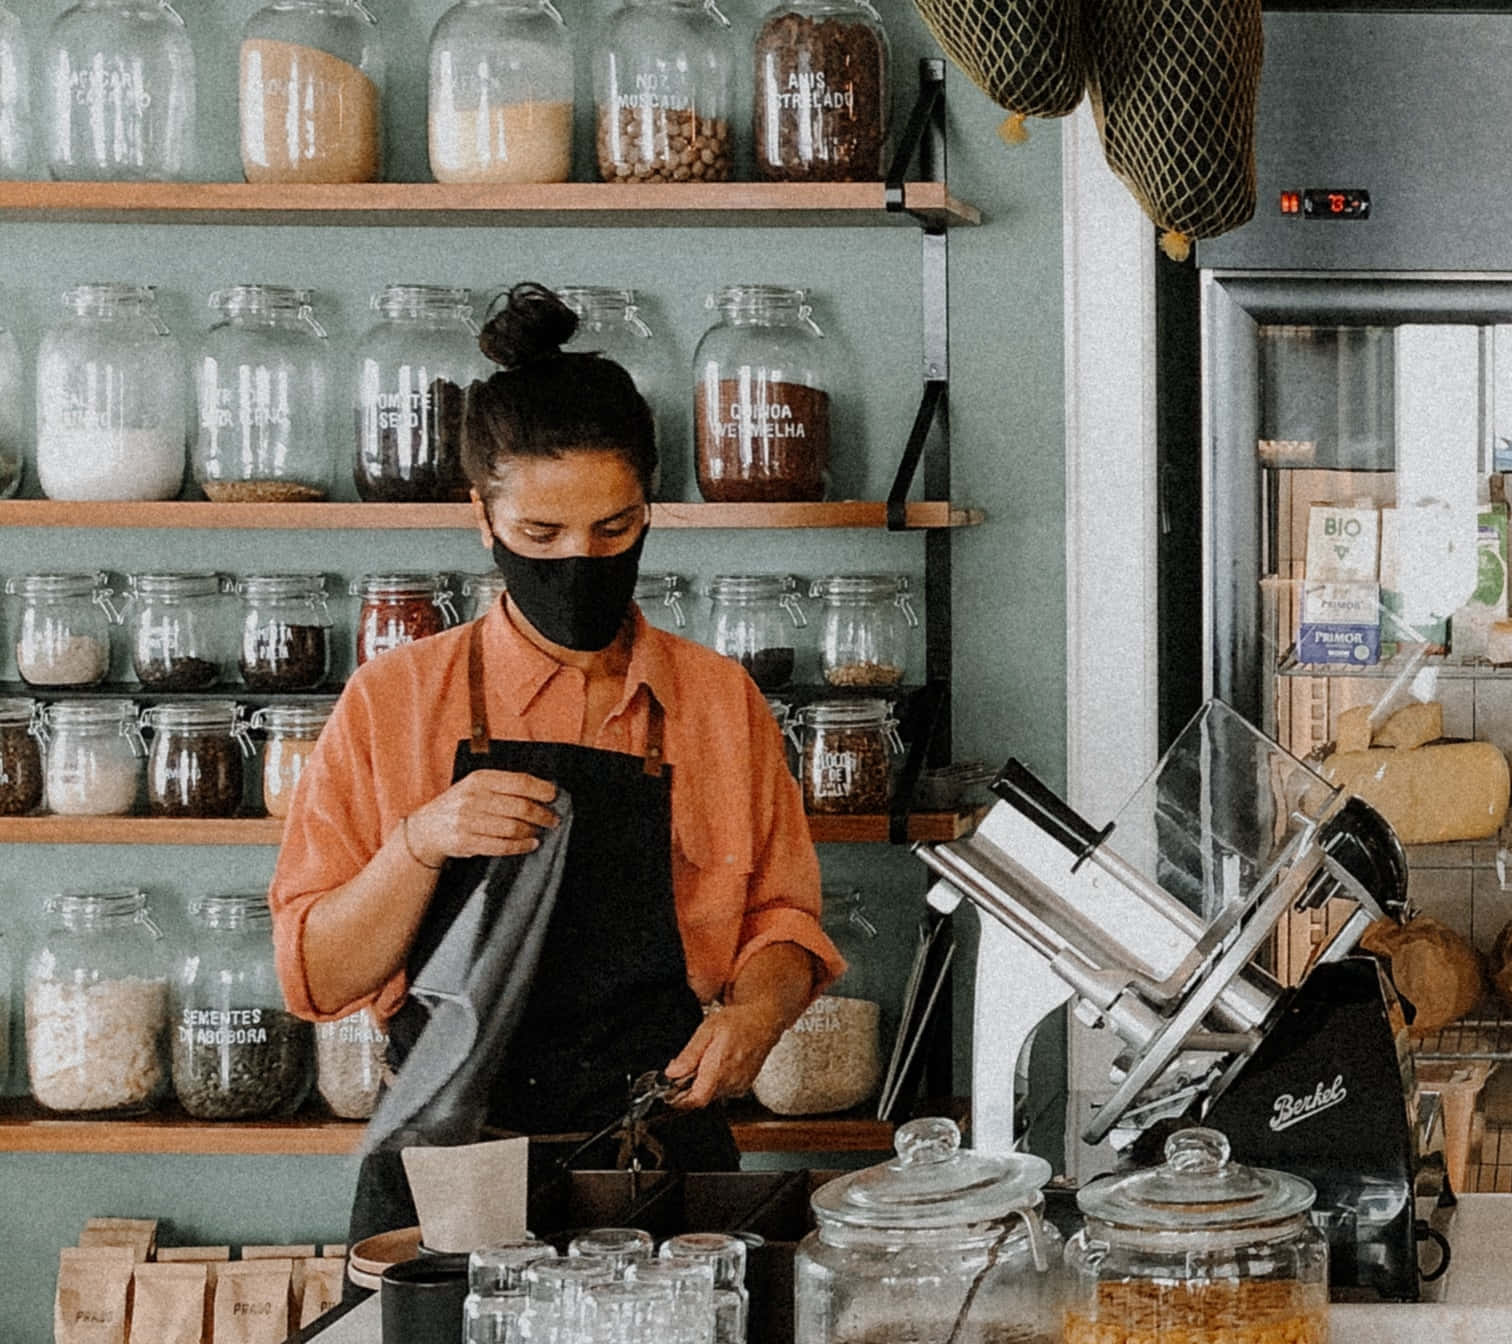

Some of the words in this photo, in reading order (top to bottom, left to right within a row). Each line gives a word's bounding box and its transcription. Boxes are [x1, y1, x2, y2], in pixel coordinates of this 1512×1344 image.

[1324, 517, 1361, 537] BIO
[183, 1008, 262, 1026] SEMENTES
[1269, 1074, 1347, 1131] Berkel
